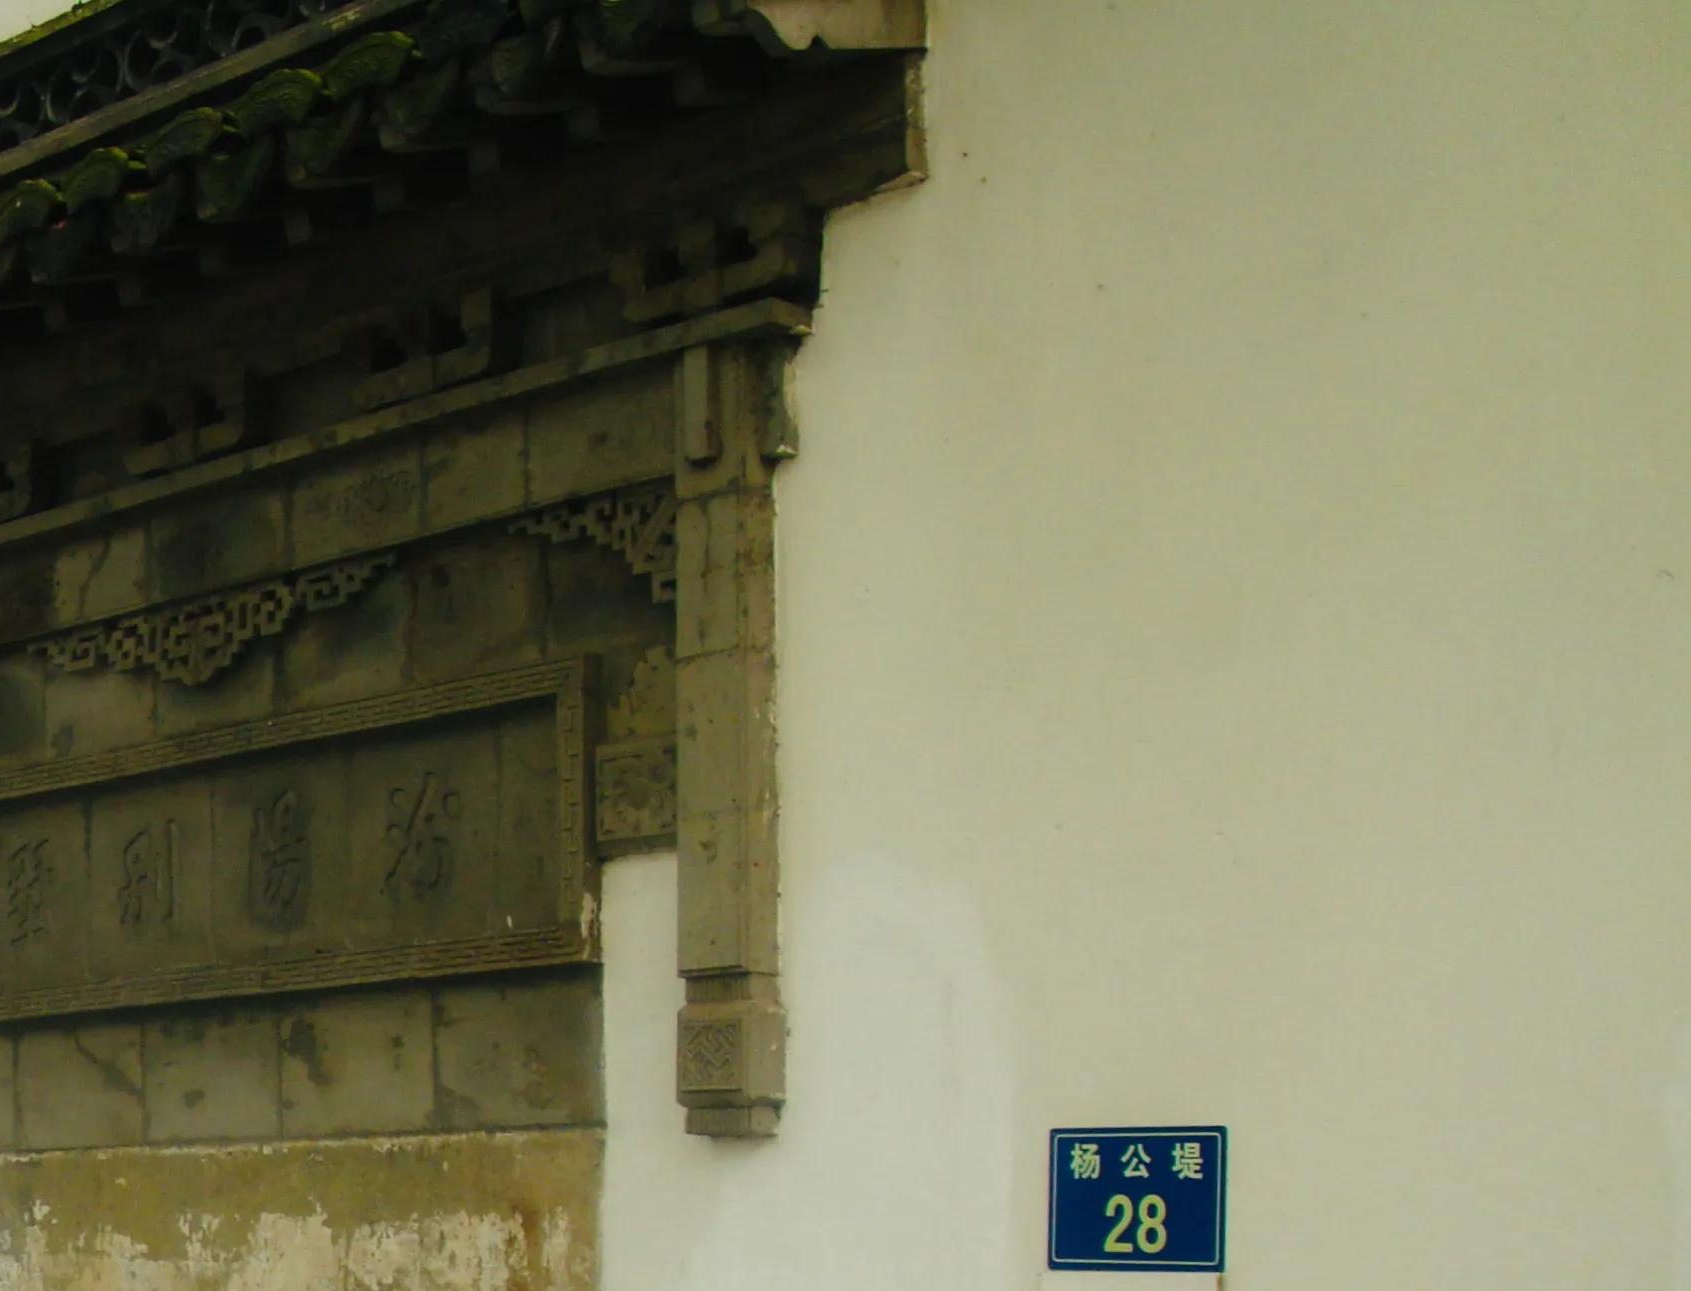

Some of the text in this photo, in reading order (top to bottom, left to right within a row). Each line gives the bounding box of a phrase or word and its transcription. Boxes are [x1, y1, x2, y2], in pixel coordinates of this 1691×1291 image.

[1070, 1142, 1203, 1180] 杨公堤
[1104, 1194, 1168, 1253] 28
